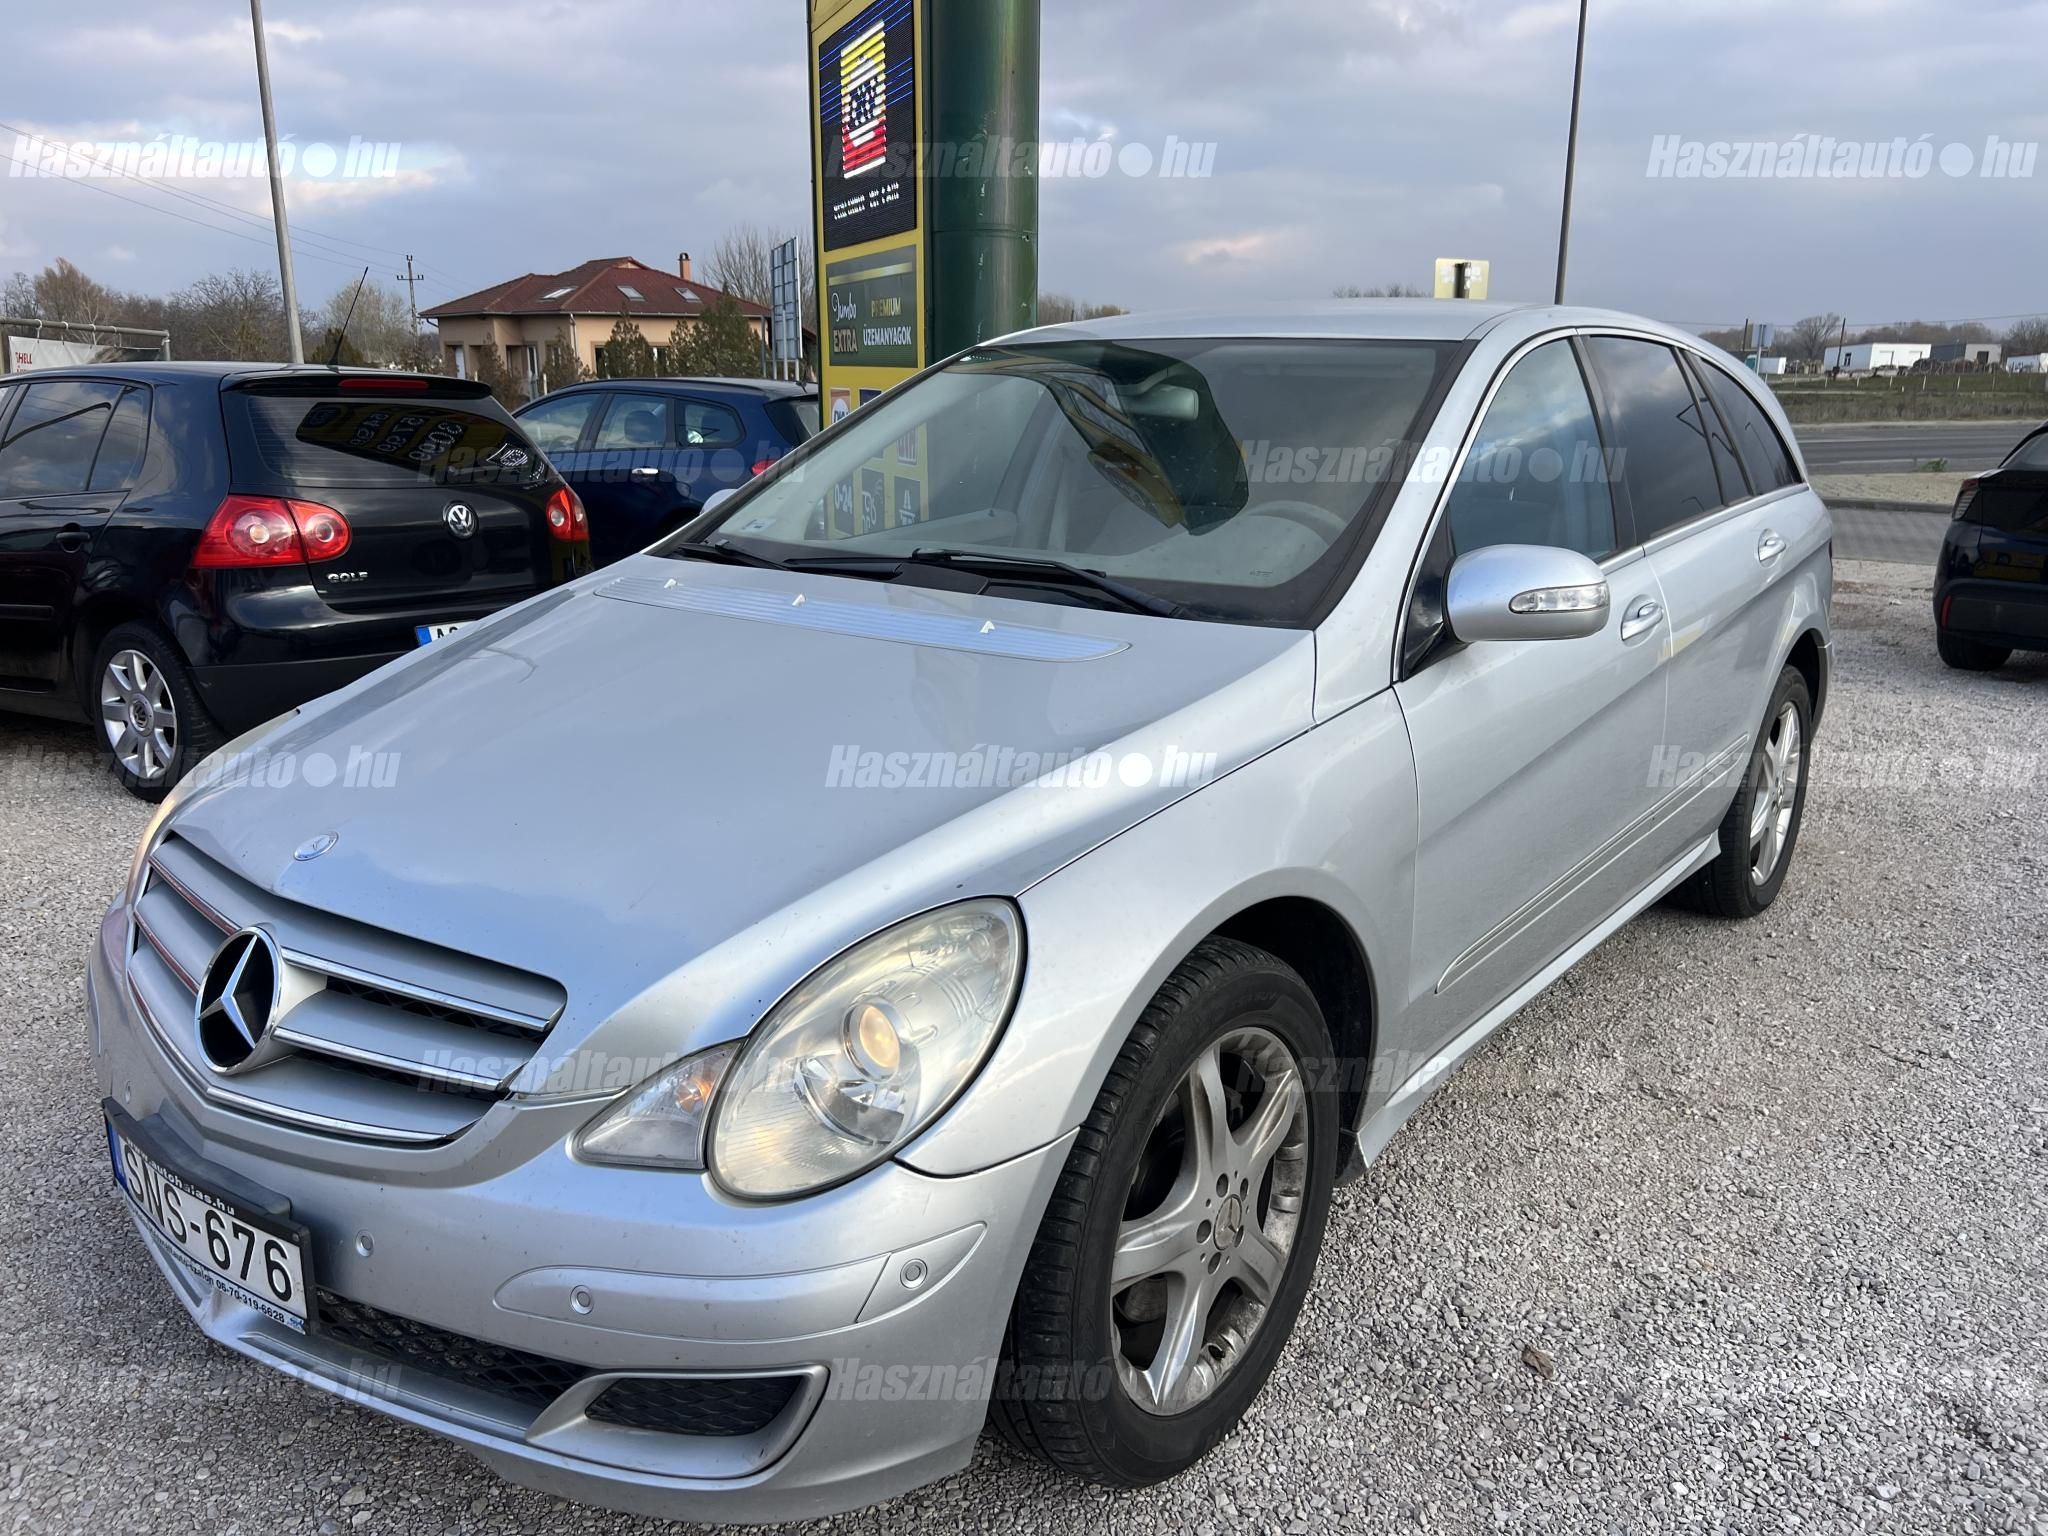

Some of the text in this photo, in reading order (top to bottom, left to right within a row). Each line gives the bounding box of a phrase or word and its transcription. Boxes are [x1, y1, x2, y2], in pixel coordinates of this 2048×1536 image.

[831, 292, 857, 322] Jumbo
[871, 297, 902, 317] PREMIUM
[833, 328, 858, 353] EXTRA
[863, 323, 912, 346] ÜZEMANYAGOK
[327, 571, 369, 583] GOLF
[124, 1143, 293, 1303] SNS-676
